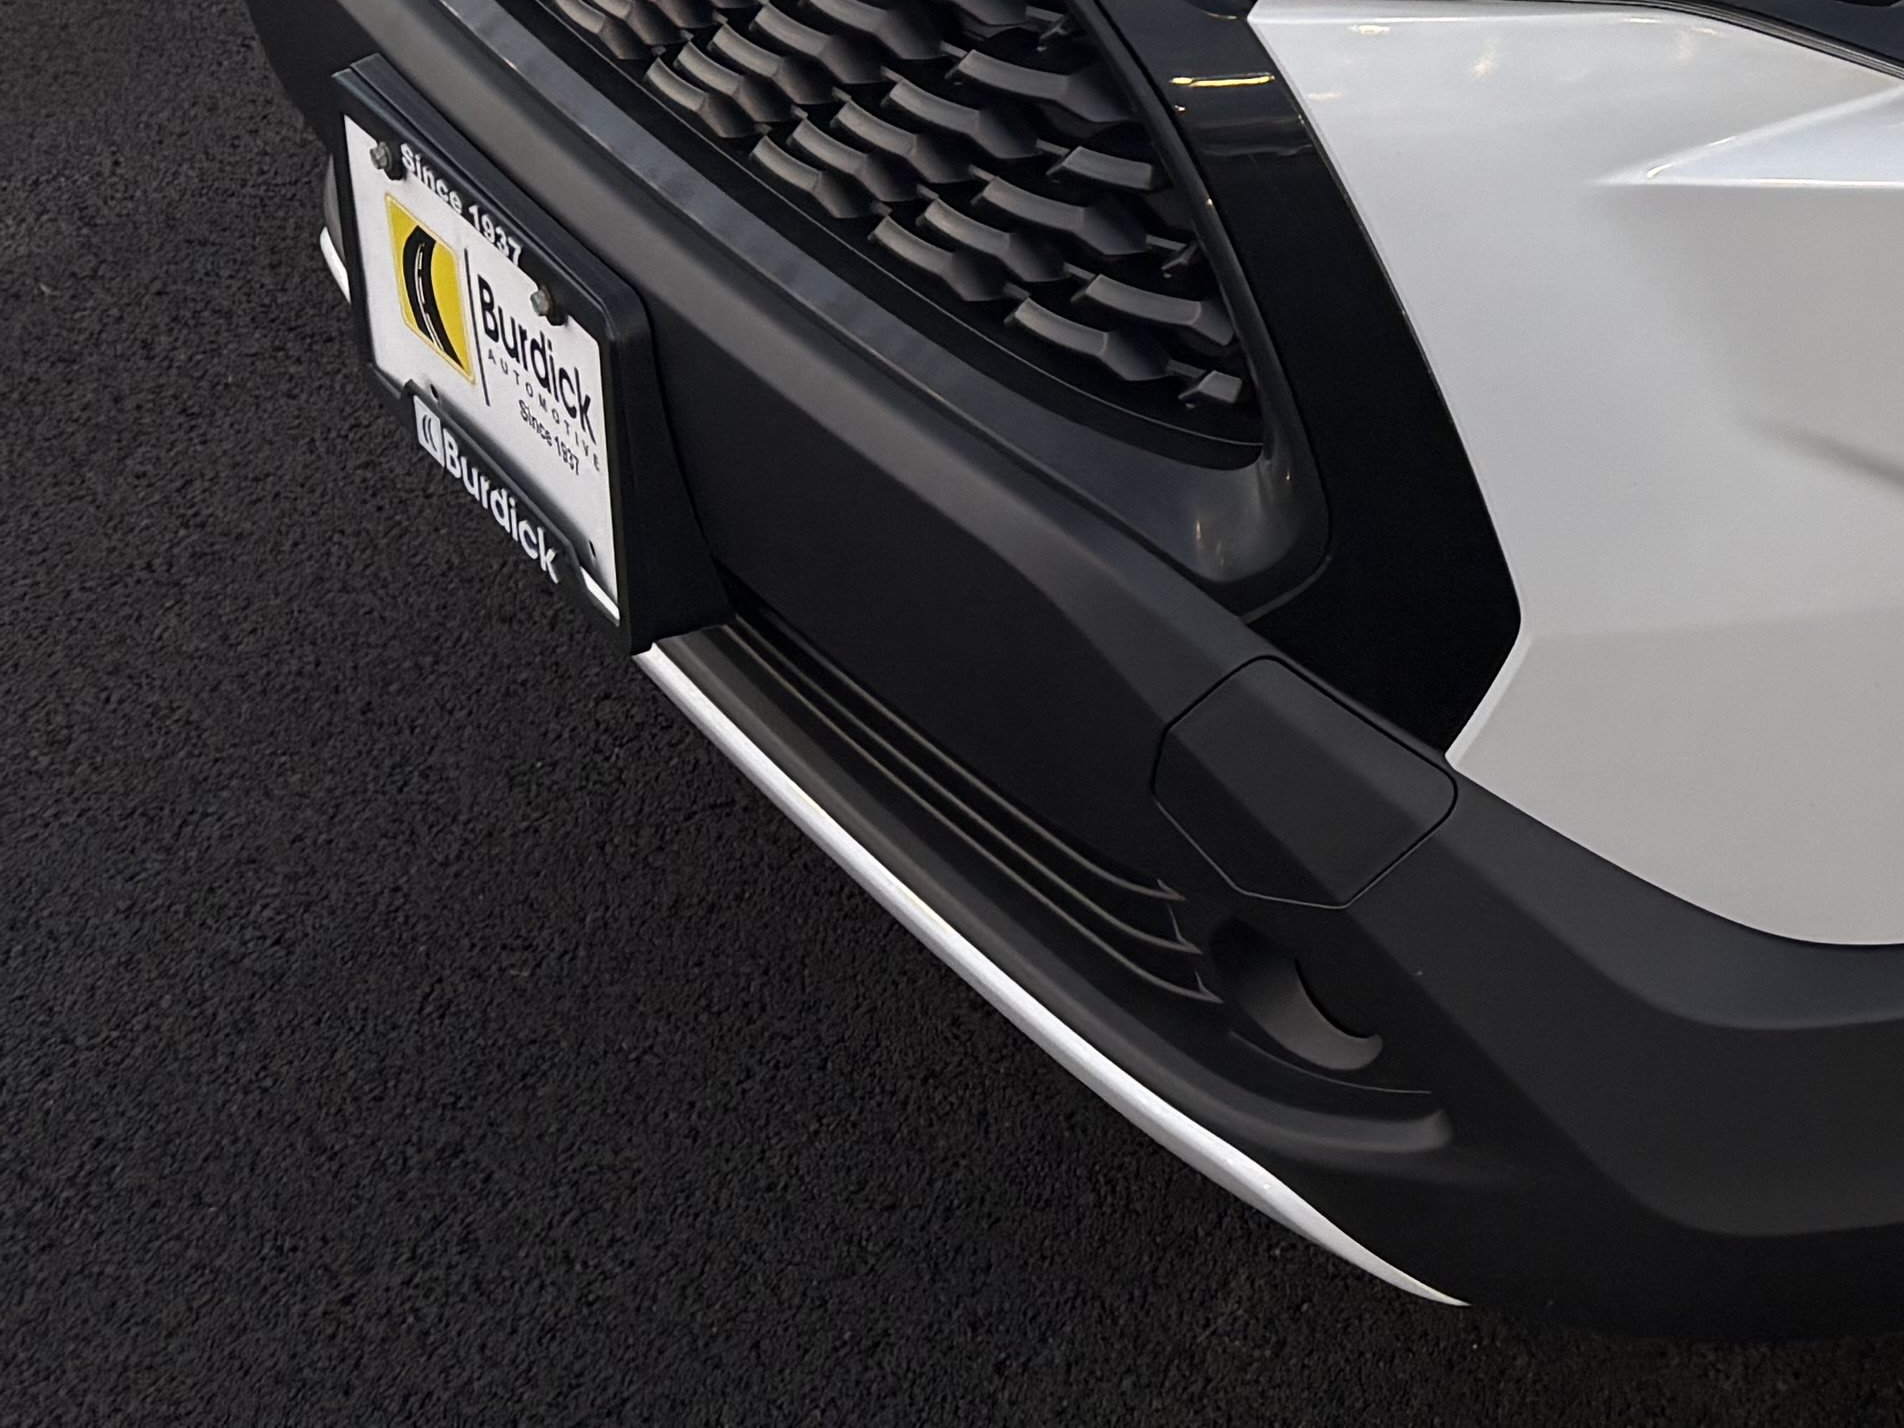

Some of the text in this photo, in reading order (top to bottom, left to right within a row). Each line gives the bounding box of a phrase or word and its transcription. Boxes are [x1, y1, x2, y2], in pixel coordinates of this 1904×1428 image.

[401, 143, 522, 267] Since 1937
[477, 273, 597, 445] Burdick
[487, 348, 600, 472] AUTOMOTIVE
[518, 399, 553, 447] Since
[442, 427, 560, 584] Burdick
